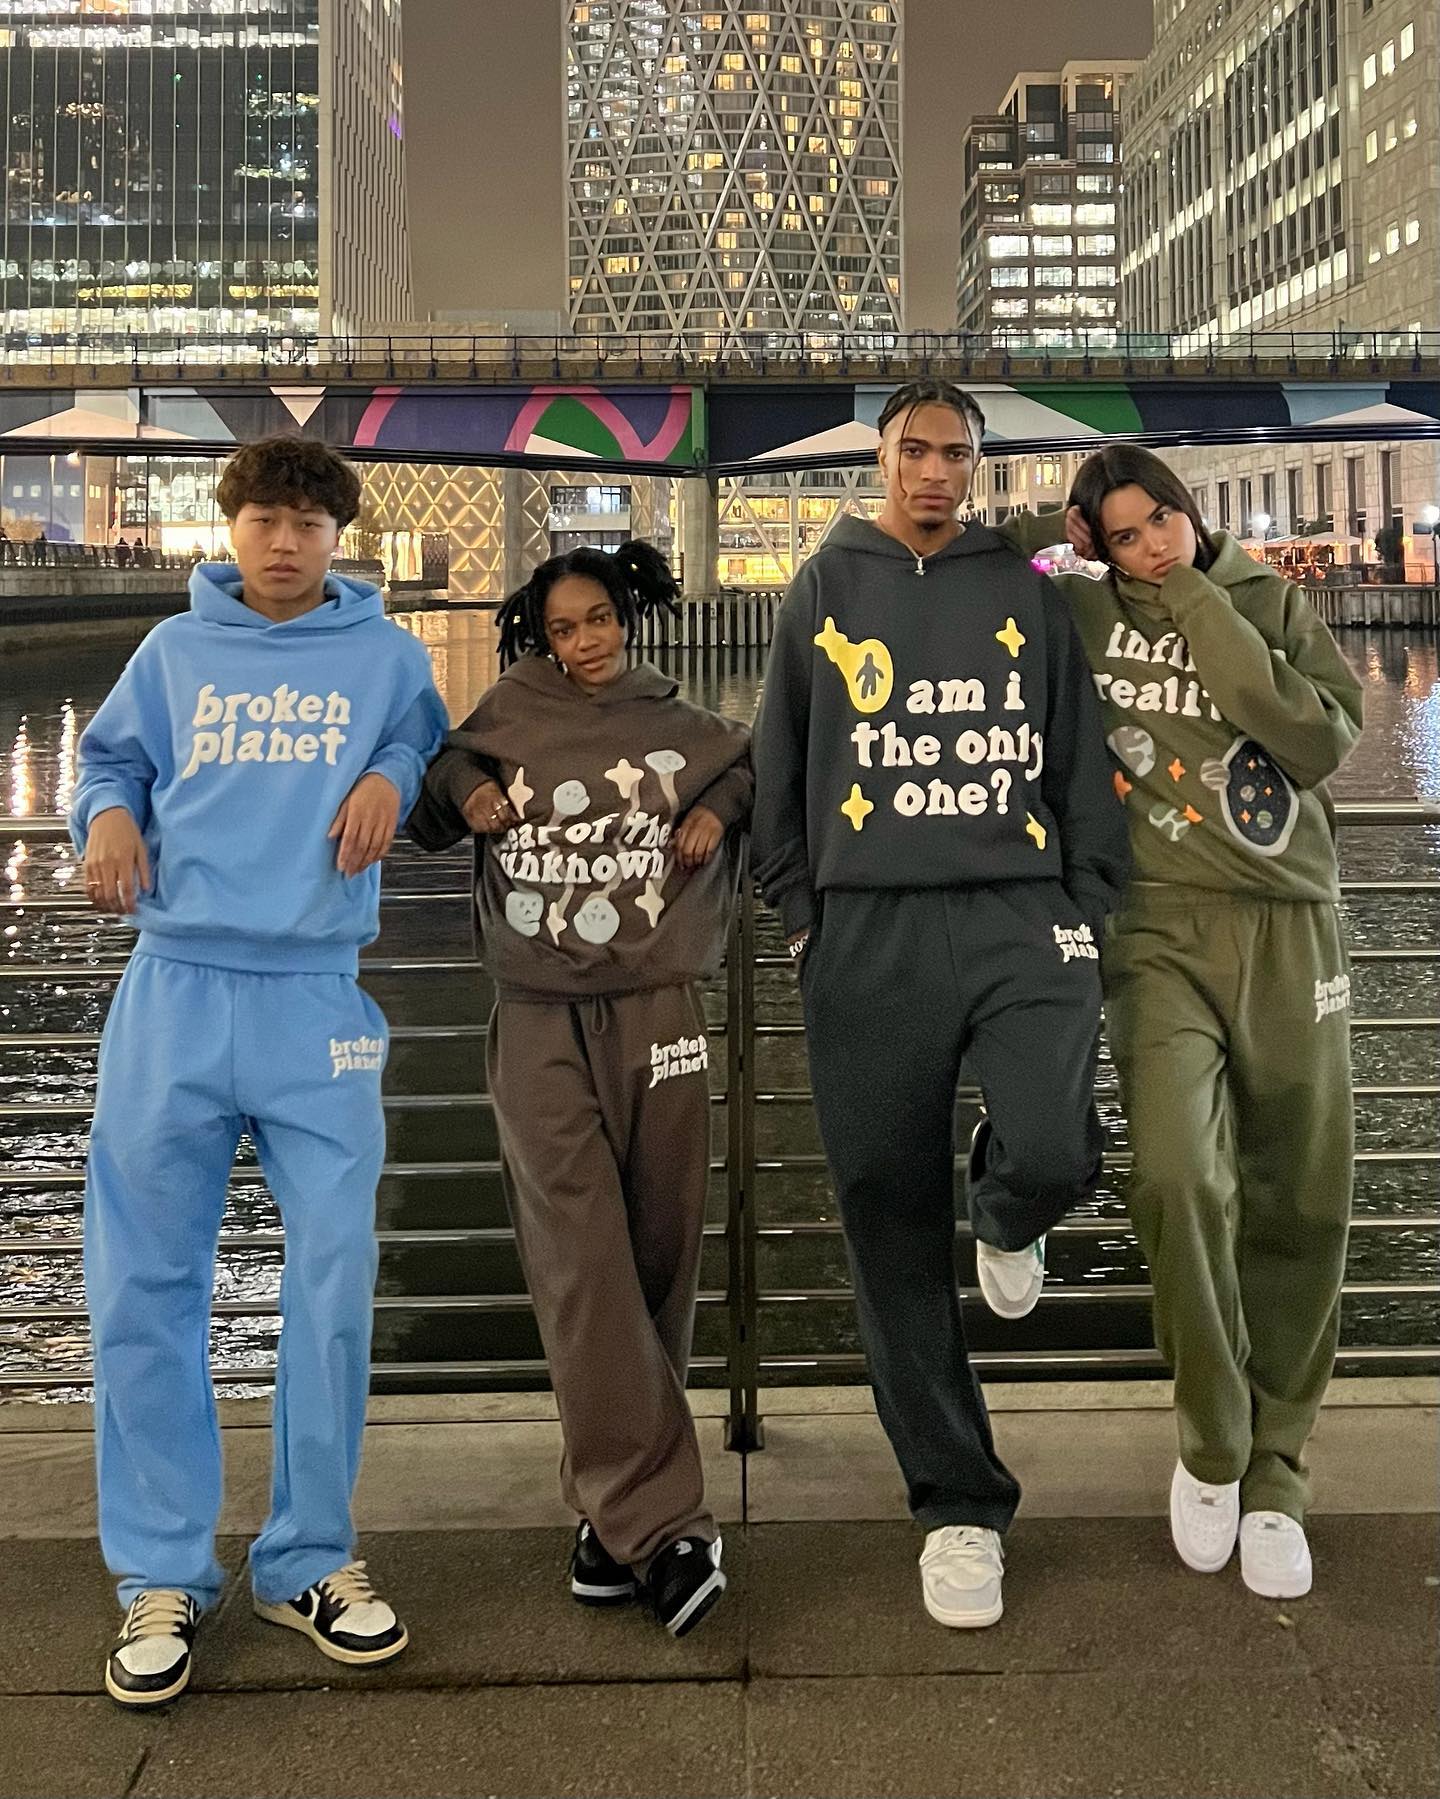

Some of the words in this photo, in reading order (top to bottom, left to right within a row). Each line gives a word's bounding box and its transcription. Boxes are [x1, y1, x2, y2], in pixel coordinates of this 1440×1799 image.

[192, 683, 350, 728] broken
[906, 678, 986, 715] am
[1004, 670, 1026, 710] i
[181, 723, 347, 780] planet
[850, 721, 942, 768] the
[955, 722, 1044, 782] only
[893, 768, 1013, 817] one?
[502, 822, 562, 852] ear
[624, 811, 671, 849] the
[499, 847, 666, 884] unknown
[648, 1050, 708, 1089] planet
[650, 1034, 707, 1066] broken
